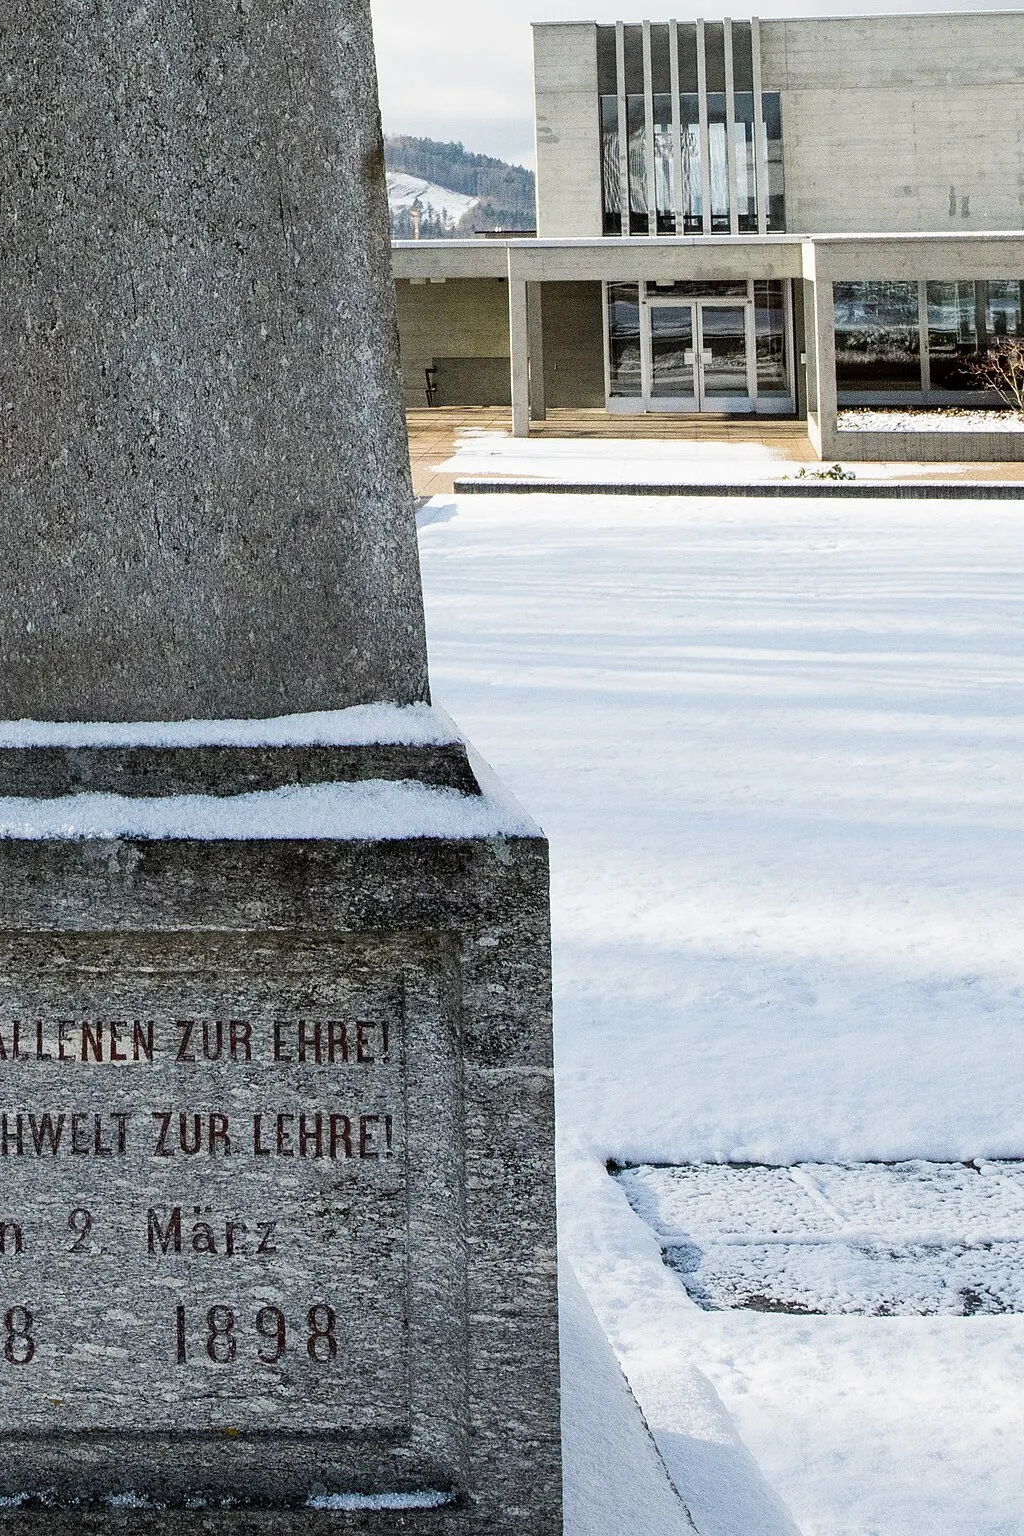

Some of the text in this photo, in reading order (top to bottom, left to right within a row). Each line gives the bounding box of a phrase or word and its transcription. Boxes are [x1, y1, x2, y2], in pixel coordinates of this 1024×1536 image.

[176, 1020, 252, 1062] ZUR
[273, 1020, 390, 1063] EHRE!
[152, 1112, 231, 1157] ZUR
[253, 1113, 394, 1158] LEHRE!
[147, 1205, 277, 1256] März
[177, 1304, 337, 1365] 1898
